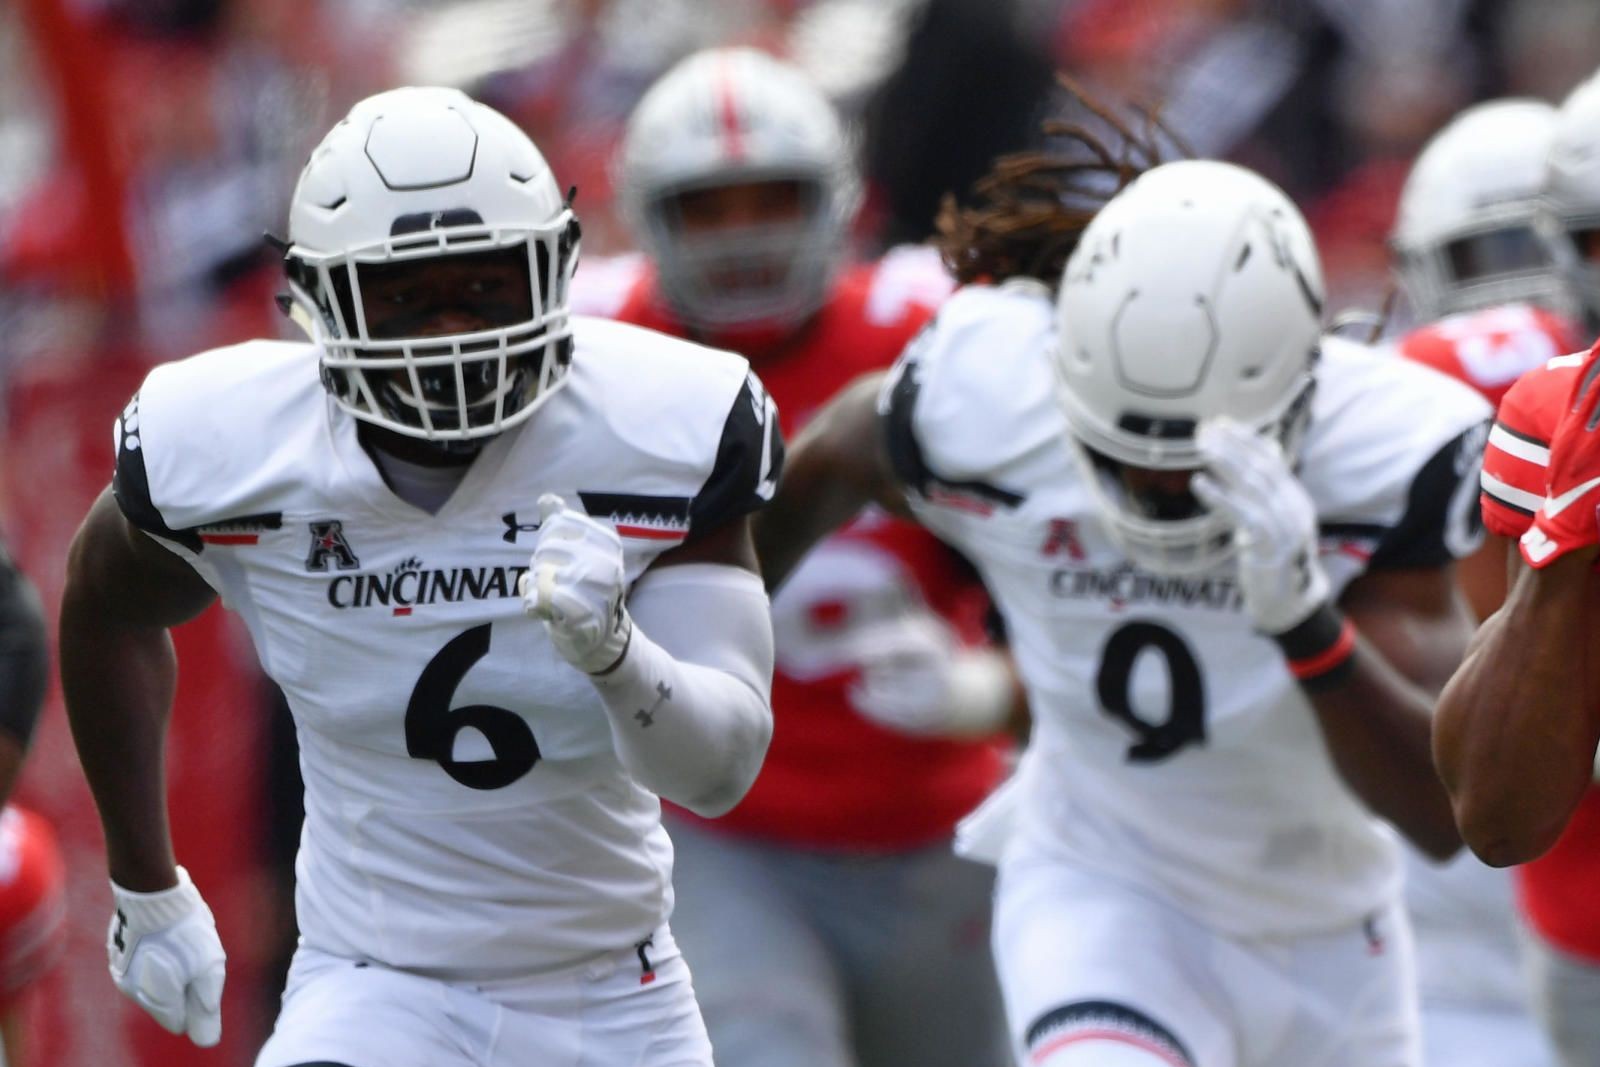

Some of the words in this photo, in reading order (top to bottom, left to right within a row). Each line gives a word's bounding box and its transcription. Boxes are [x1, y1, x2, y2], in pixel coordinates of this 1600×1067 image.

[327, 560, 531, 611] CINCINNAT
[404, 622, 542, 790] 6
[1096, 618, 1208, 766] 9
